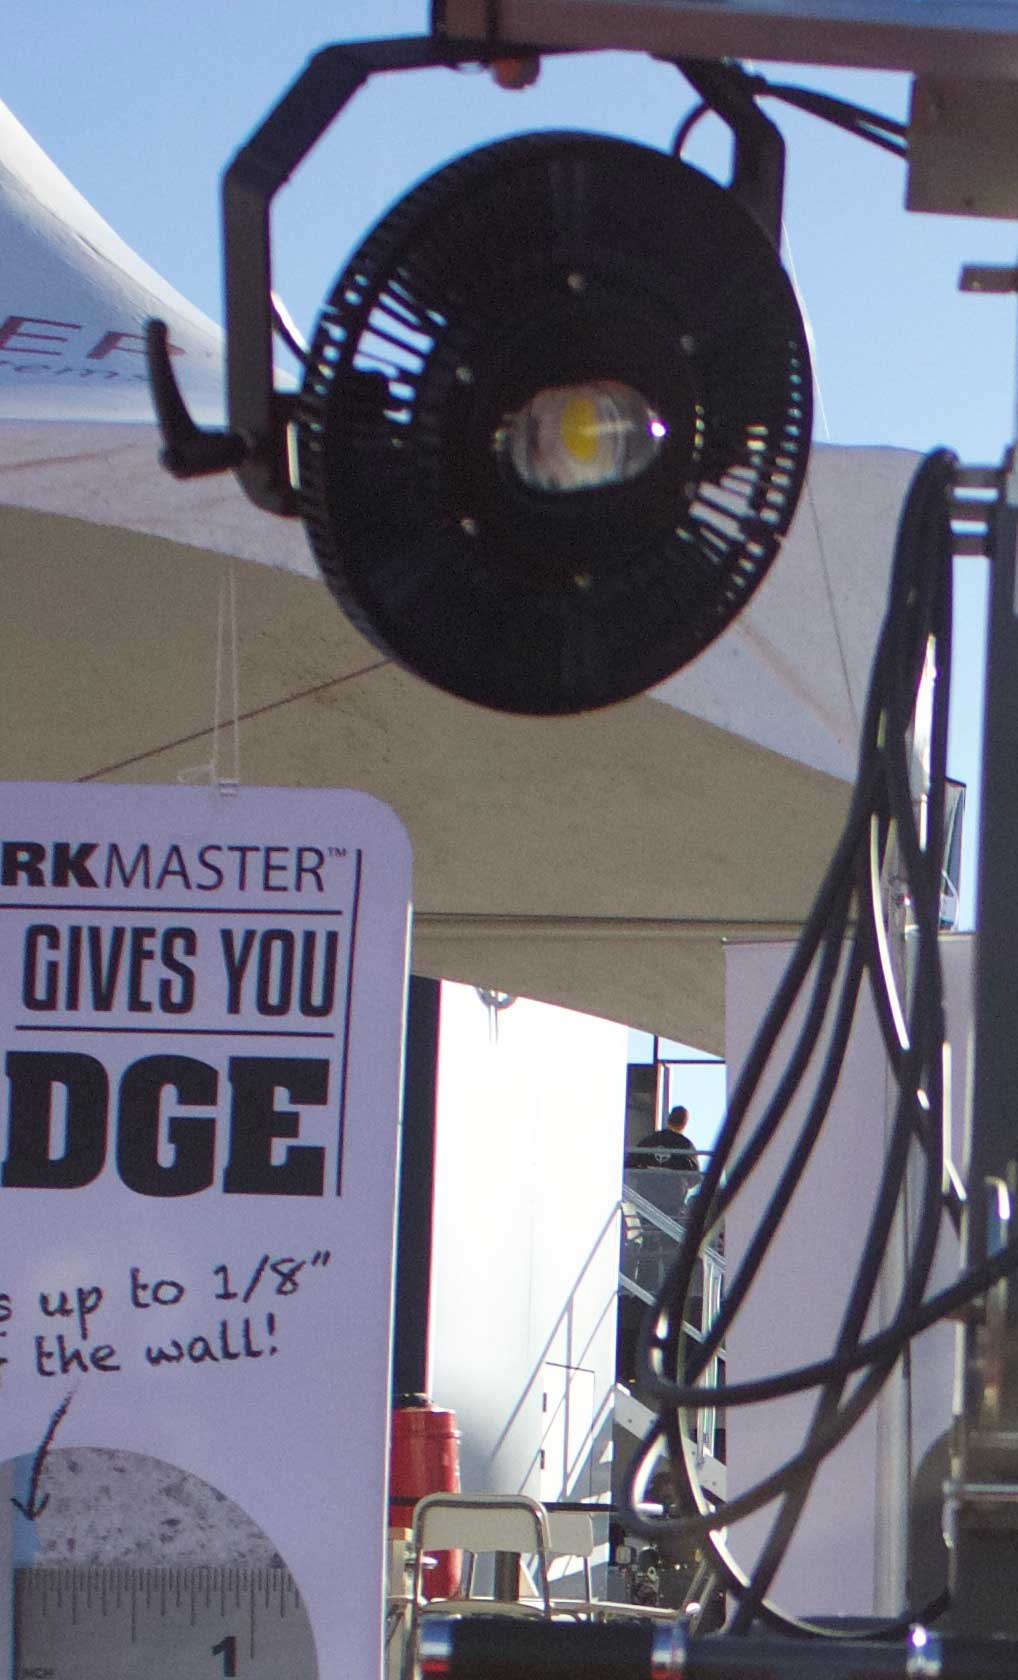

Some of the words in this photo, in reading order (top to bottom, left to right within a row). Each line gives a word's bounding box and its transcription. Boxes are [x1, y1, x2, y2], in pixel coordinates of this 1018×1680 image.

[22, 923, 198, 1015] GIVES
[220, 928, 340, 1018] YOU
[0, 1050, 331, 1198] DGE
[39, 1285, 104, 1341] up
[130, 1266, 186, 1309] to
[35, 1333, 121, 1377] the
[146, 1312, 278, 1365] wall!
[212, 1636, 238, 1678] 1
